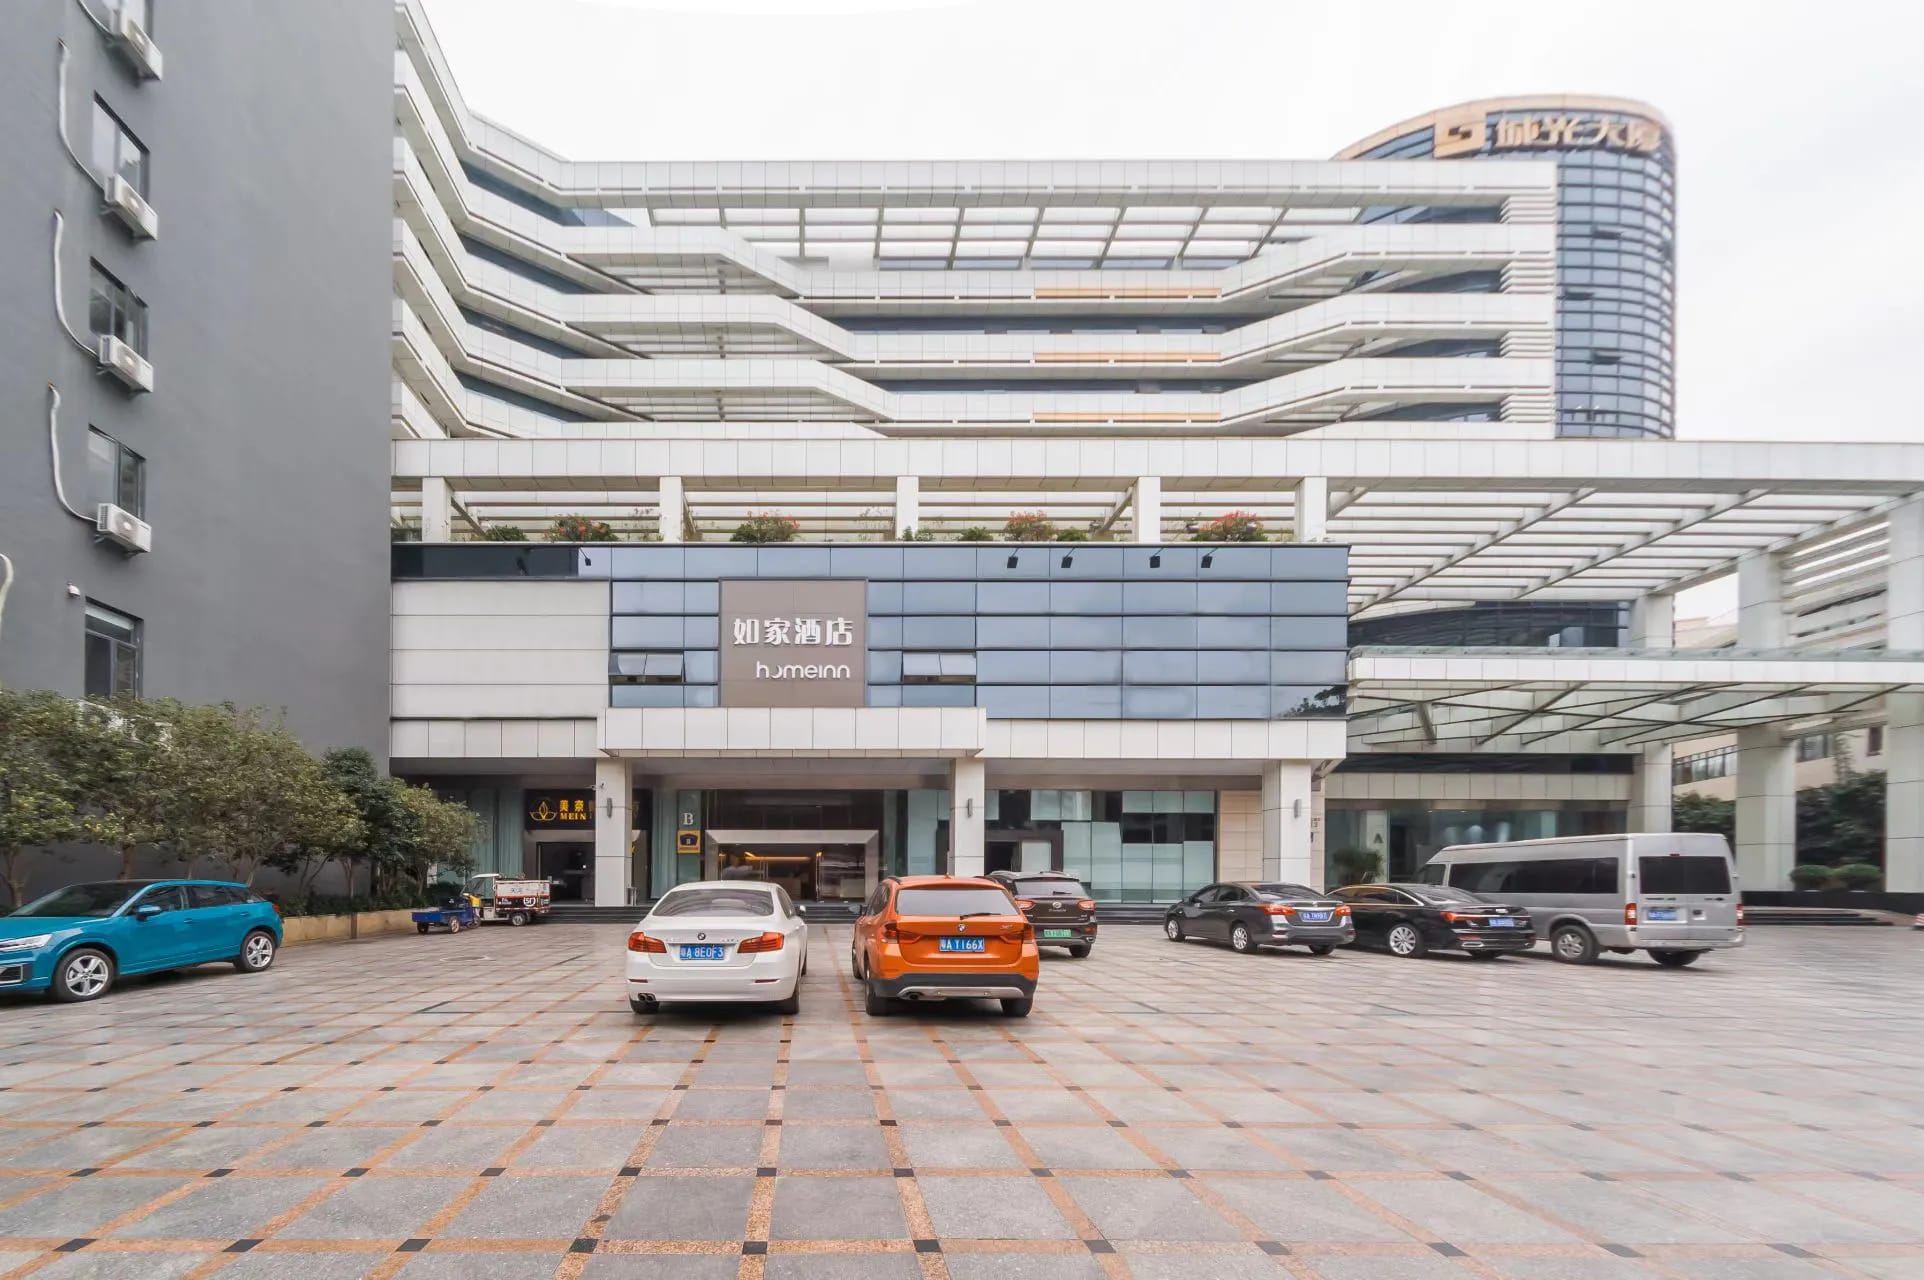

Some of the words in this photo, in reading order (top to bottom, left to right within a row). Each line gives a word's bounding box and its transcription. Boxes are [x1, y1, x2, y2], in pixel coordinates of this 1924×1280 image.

[733, 617, 853, 646] 如家酒店
[683, 812, 694, 825] B
